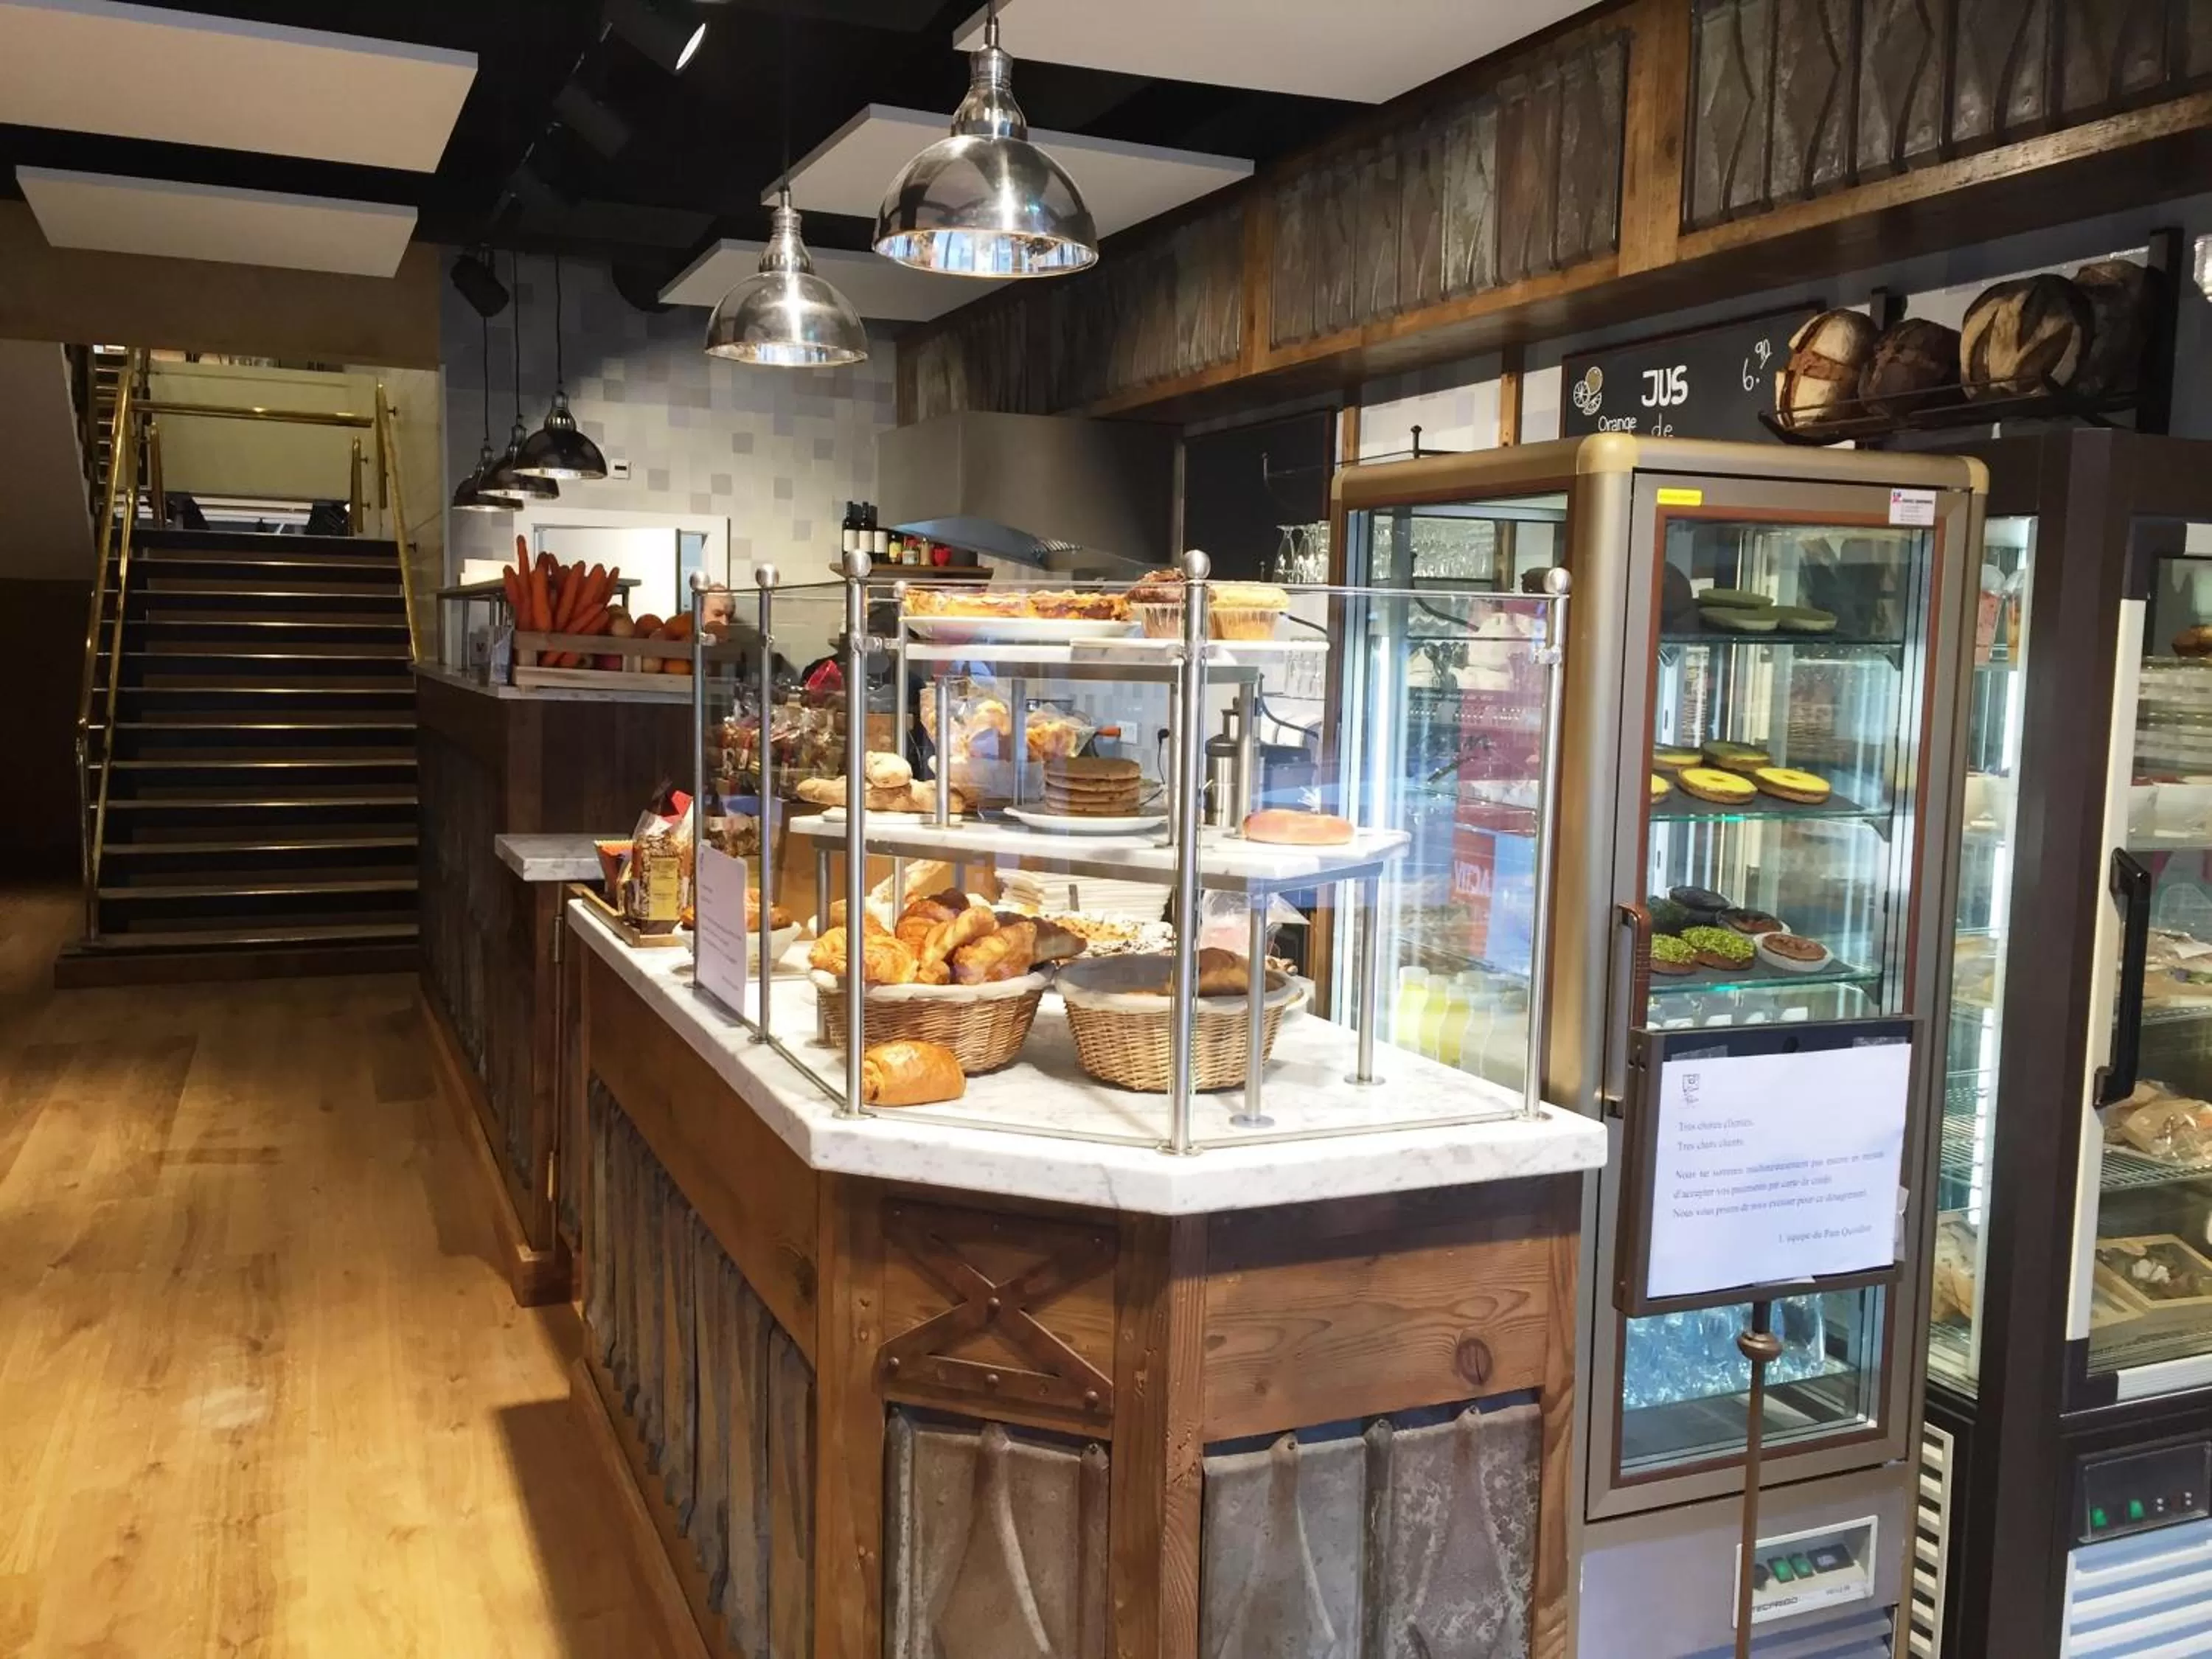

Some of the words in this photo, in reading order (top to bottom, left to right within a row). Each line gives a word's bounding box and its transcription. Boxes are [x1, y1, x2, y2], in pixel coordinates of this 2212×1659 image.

[1641, 365, 1688, 407] JUS
[1598, 415, 1637, 434] Orange
[1652, 413, 1674, 437] de
